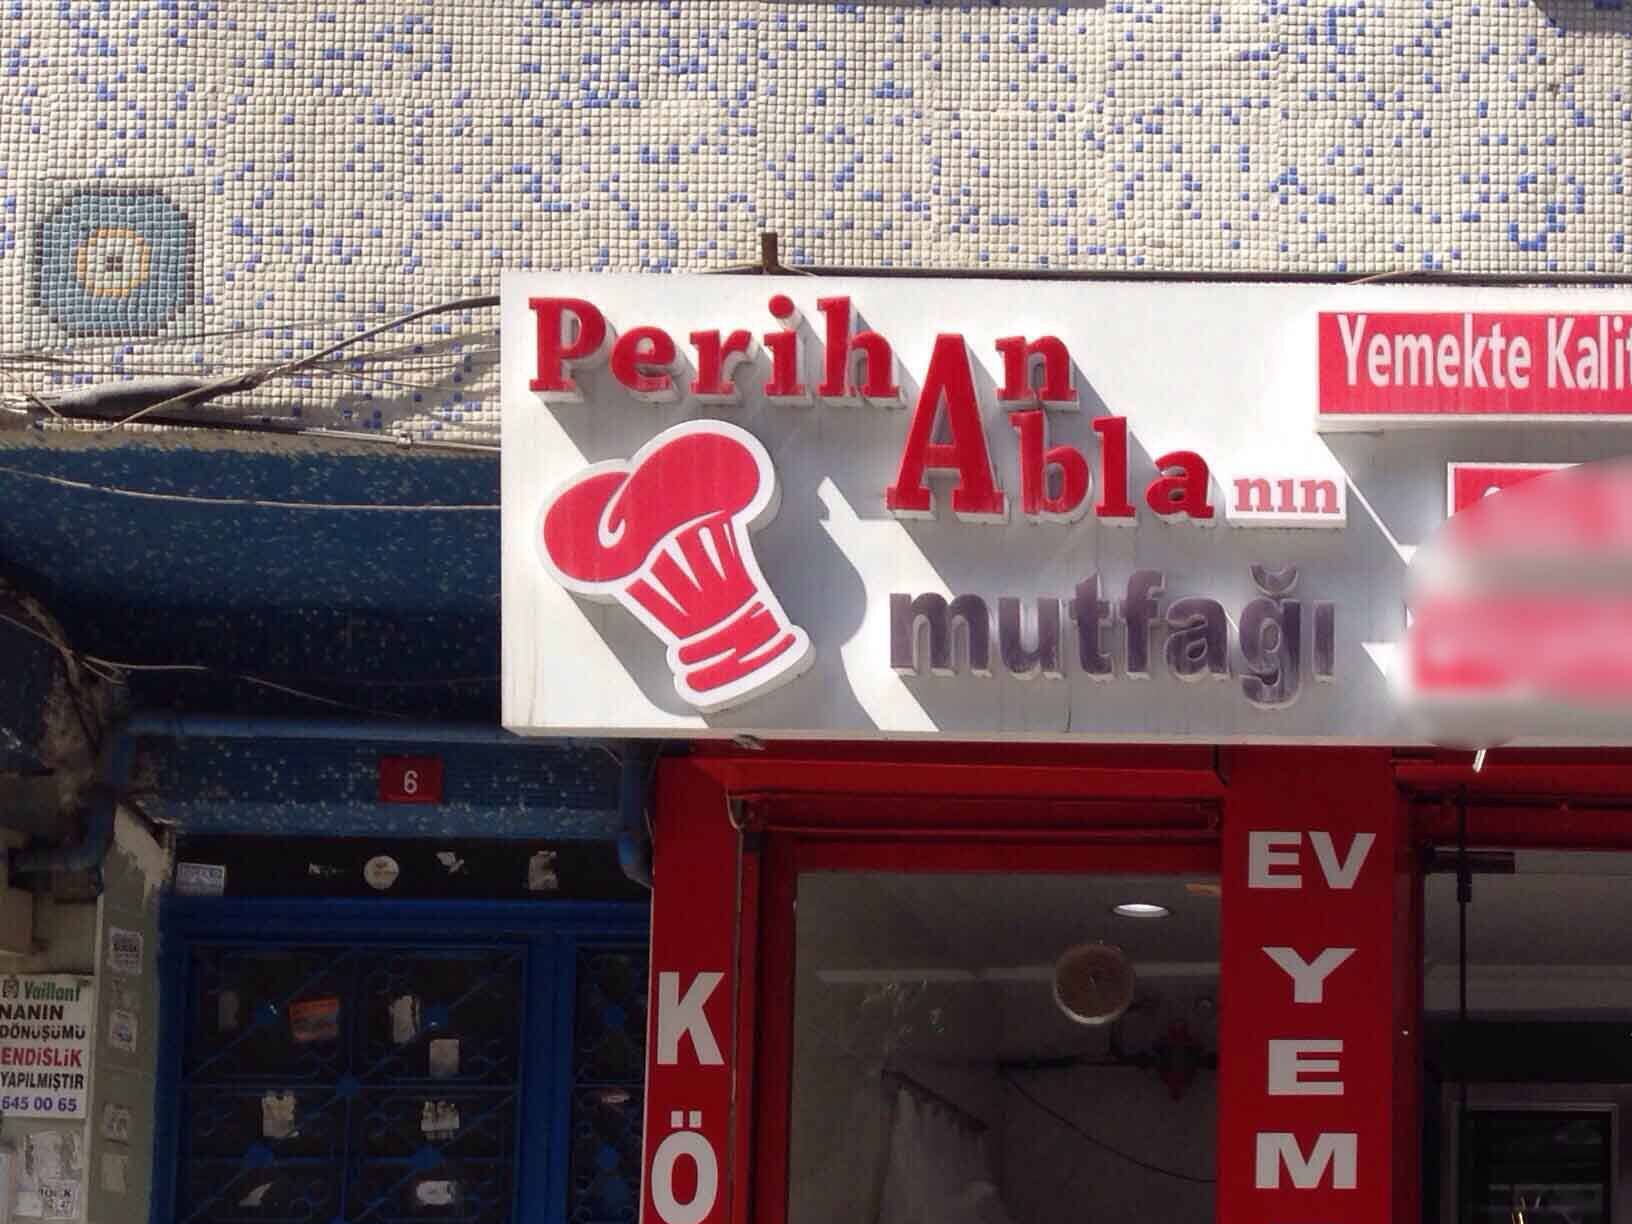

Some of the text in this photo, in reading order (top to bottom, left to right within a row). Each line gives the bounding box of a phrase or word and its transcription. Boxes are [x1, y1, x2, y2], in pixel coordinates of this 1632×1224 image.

[1340, 314, 1531, 391] Yemekte
[889, 564, 1336, 707] mutfağı
[403, 770, 419, 794] 6
[1247, 831, 1377, 889] EV
[34, 1097, 53, 1112] 00
[58, 1098, 78, 1113] 65
